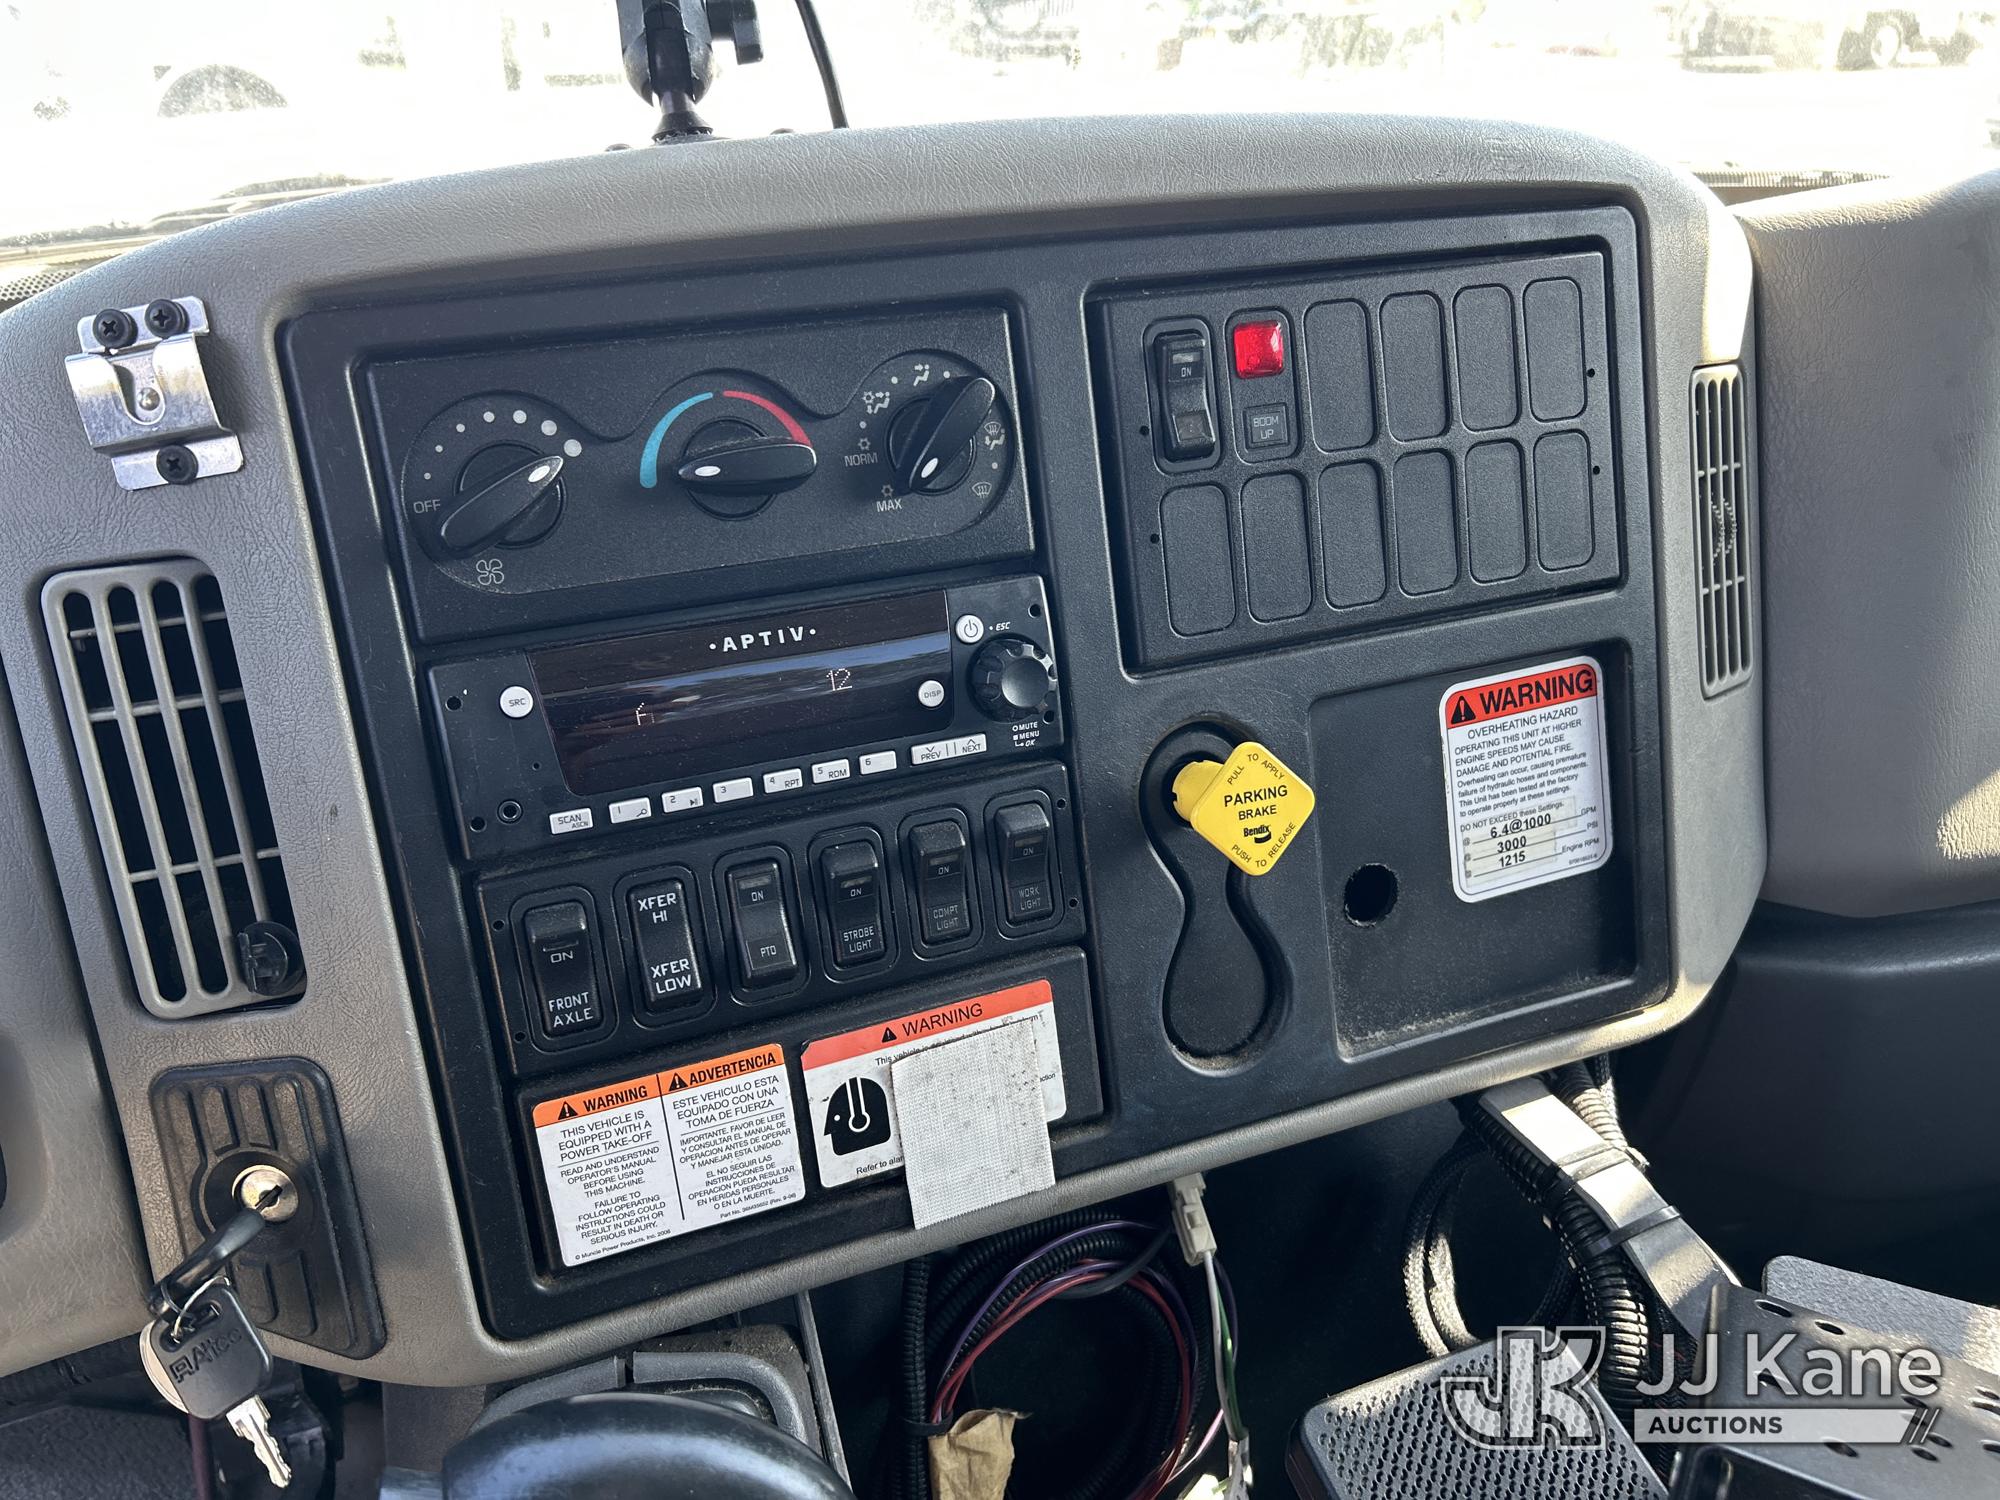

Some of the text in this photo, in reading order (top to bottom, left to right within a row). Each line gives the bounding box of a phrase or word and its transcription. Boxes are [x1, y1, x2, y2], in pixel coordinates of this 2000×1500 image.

[1181, 366, 1192, 378] ON
[1253, 415, 1279, 427] BOOM
[1260, 429, 1274, 439] UP
[844, 452, 878, 467] NORM
[413, 499, 440, 514] OFF
[876, 498, 902, 512] MAX
[995, 621, 1011, 632] ESC
[723, 626, 804, 652] APTIV
[923, 690, 942, 699] DISP
[1479, 667, 1593, 716] WARNING
[508, 697, 527, 708] SRC
[1018, 721, 1038, 731] MUTE
[1467, 705, 1578, 739] OVERHEATING HAZARD
[1019, 730, 1040, 740] MENU
[1025, 739, 1036, 747] OK
[1454, 717, 1581, 755] OPERATING THIS UNIT AT HIGHER
[921, 750, 941, 761] PREV
[962, 742, 981, 753] NEXT
[1455, 733, 1564, 766] ENGINE SPEEDS MAY CAUSE
[865, 757, 871, 766] 6
[1227, 753, 1285, 786] PULL TO APPLY
[1456, 762, 1490, 777] DAMAGE
[1491, 758, 1508, 769] AND
[1510, 747, 1552, 764] POTENTIAL
[817, 767, 823, 775] 5
[720, 786, 727, 794] 3
[769, 776, 800, 788] 4 RPT
[670, 795, 676, 804] 2
[1224, 784, 1289, 808] PARKING
[557, 813, 582, 826] SCAN
[1238, 804, 1278, 821] BRAKE
[1459, 823, 1471, 832] DO
[1472, 818, 1487, 828] NOT
[1488, 811, 1517, 825] EXCEED
[1518, 807, 1536, 817] these
[1489, 805, 1596, 839] 6.4@1000 GPM
[1243, 824, 1271, 838] Bendix
[1496, 820, 1598, 853] 3000 PSI
[1023, 846, 1035, 856] ON
[1231, 822, 1296, 868] PUSH TO RELEASE
[1498, 836, 1599, 868] 1215 Engine RPM
[938, 865, 950, 875] ON
[751, 890, 764, 901] ON
[850, 887, 862, 897] ON
[1019, 885, 1040, 899] WORK
[638, 892, 677, 912] XFER
[1020, 897, 1041, 911] LIGHT
[652, 910, 668, 924] HI
[933, 905, 959, 920] COMPT
[936, 917, 959, 931] LIGHT
[843, 925, 875, 942] STROBE
[760, 945, 777, 957] PTO
[849, 939, 872, 953] LIGHT
[550, 950, 574, 964] ON
[651, 958, 690, 979] XFER
[656, 974, 692, 994] LOW
[549, 991, 590, 1013] FRONT
[553, 1007, 594, 1028] AXLE
[902, 1002, 983, 1037] WARNING
[689, 1052, 776, 1085] ADVERTENCIA
[874, 1053, 892, 1067] This
[582, 1084, 647, 1112] WARNING
[672, 1074, 779, 1109] ESTE VEHICULO ESTA
[676, 1086, 778, 1120] EQUIPADO CON UNA
[685, 1098, 774, 1128] TOMA DE FUERZA
[729, 1120, 754, 1132] FAVOR
[755, 1117, 765, 1125] DE
[766, 1111, 785, 1122] LEER
[559, 1109, 644, 1138] THIS VEHICLE IS
[558, 1119, 652, 1151] EQUIPPED WITH A
[680, 1120, 786, 1154] Y CONSULTAR EL MANUAL DE
[560, 1129, 652, 1162] POWER TAKE-OFF
[679, 1127, 791, 1163] OPERACION ANTES DE OPERAR
[560, 1146, 659, 1177] READ AND UNDERSTAND
[620, 1156, 656, 1171] MANUAL
[697, 1152, 733, 1167] MANEJAR
[733, 1147, 752, 1157] ESTA
[855, 1153, 904, 1175] Refer to alar
[582, 1167, 644, 1189] BEFORE USING
[584, 1187, 603, 1198] THIS
[594, 1190, 641, 1209] FAILURE TO
[575, 1201, 665, 1231] INSTRUCTIONS COULD
[577, 1194, 660, 1222] FOLLOW OPERATING
[580, 1210, 664, 1239] RESULT IN DEATH OR
[590, 1229, 626, 1244] SERIOUS
